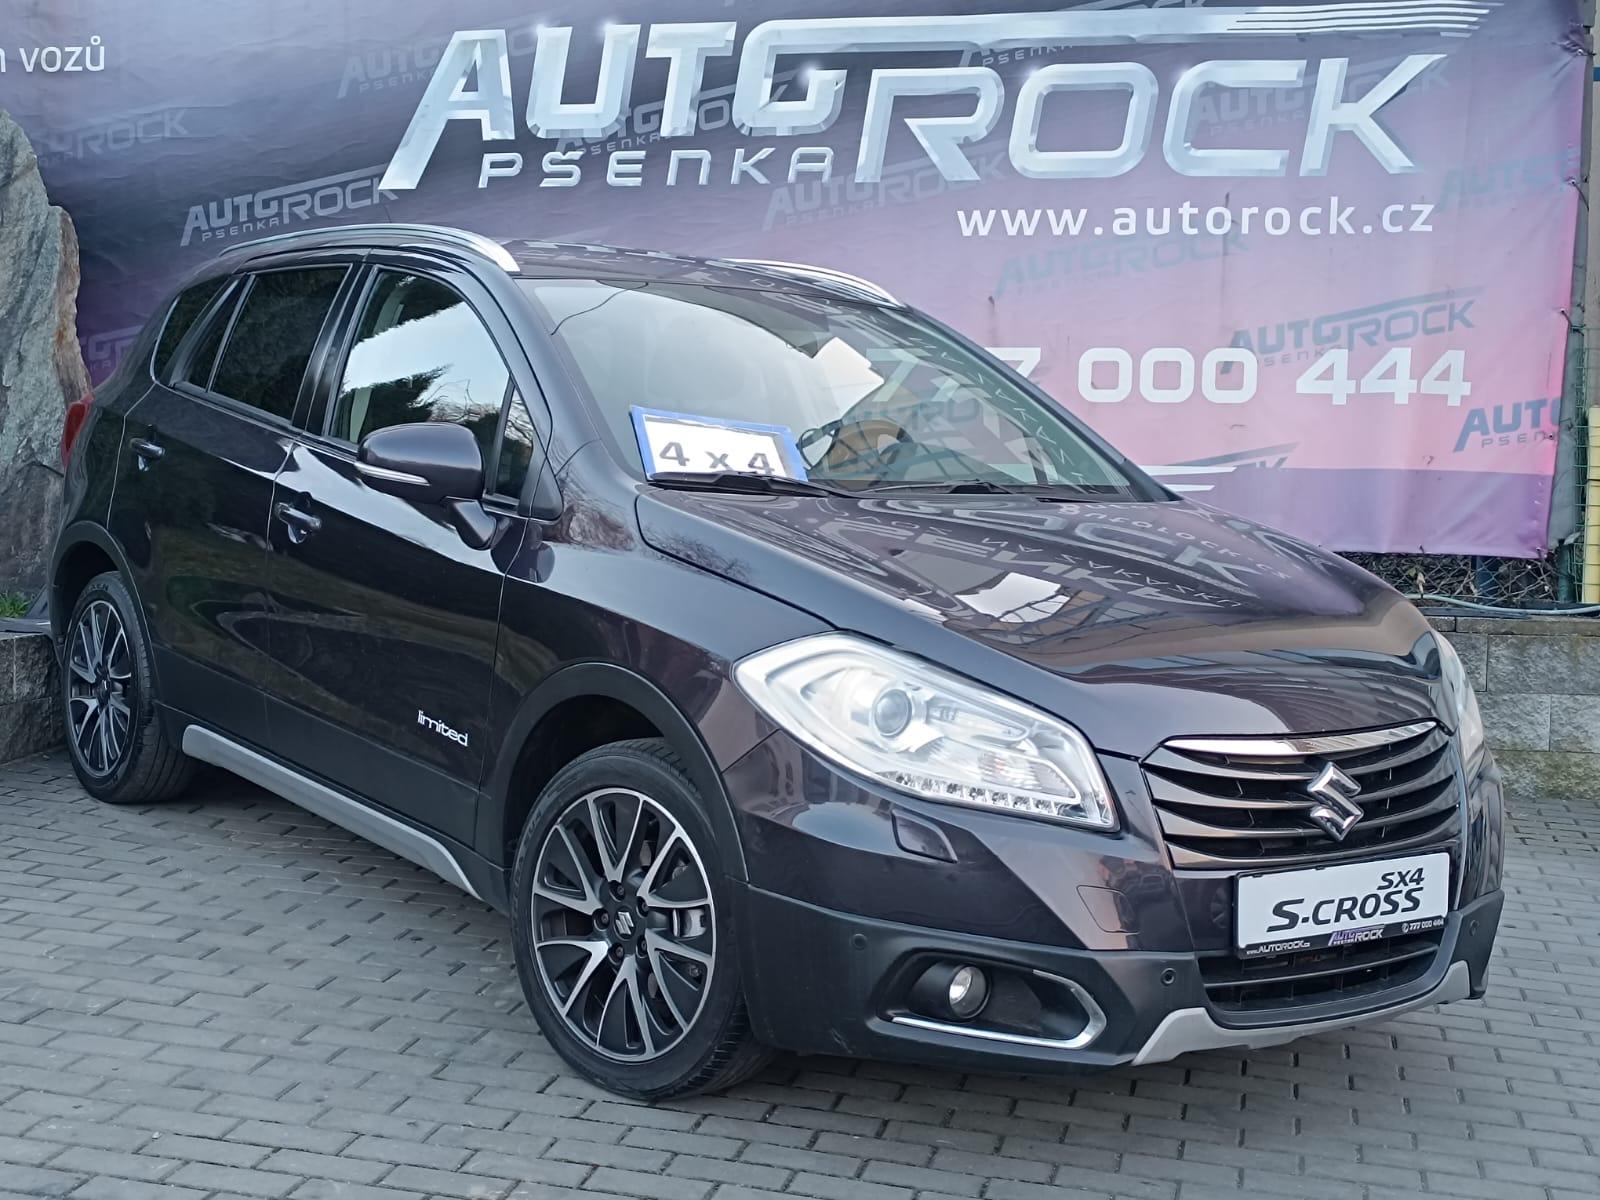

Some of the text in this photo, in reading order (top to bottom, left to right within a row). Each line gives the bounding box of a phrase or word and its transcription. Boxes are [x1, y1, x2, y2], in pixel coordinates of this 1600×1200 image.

[19, 35, 105, 73] vozů
[379, 8, 1450, 190] AUTOROCK
[957, 196, 1434, 237] www.autorock.cz
[1078, 347, 1258, 404] 000
[1296, 347, 1472, 407] 444
[659, 441, 690, 467] 4
[747, 452, 776, 476] 4
[417, 709, 469, 747] limited
[1377, 867, 1425, 891] SX4
[1266, 886, 1424, 933] S-CROSS
